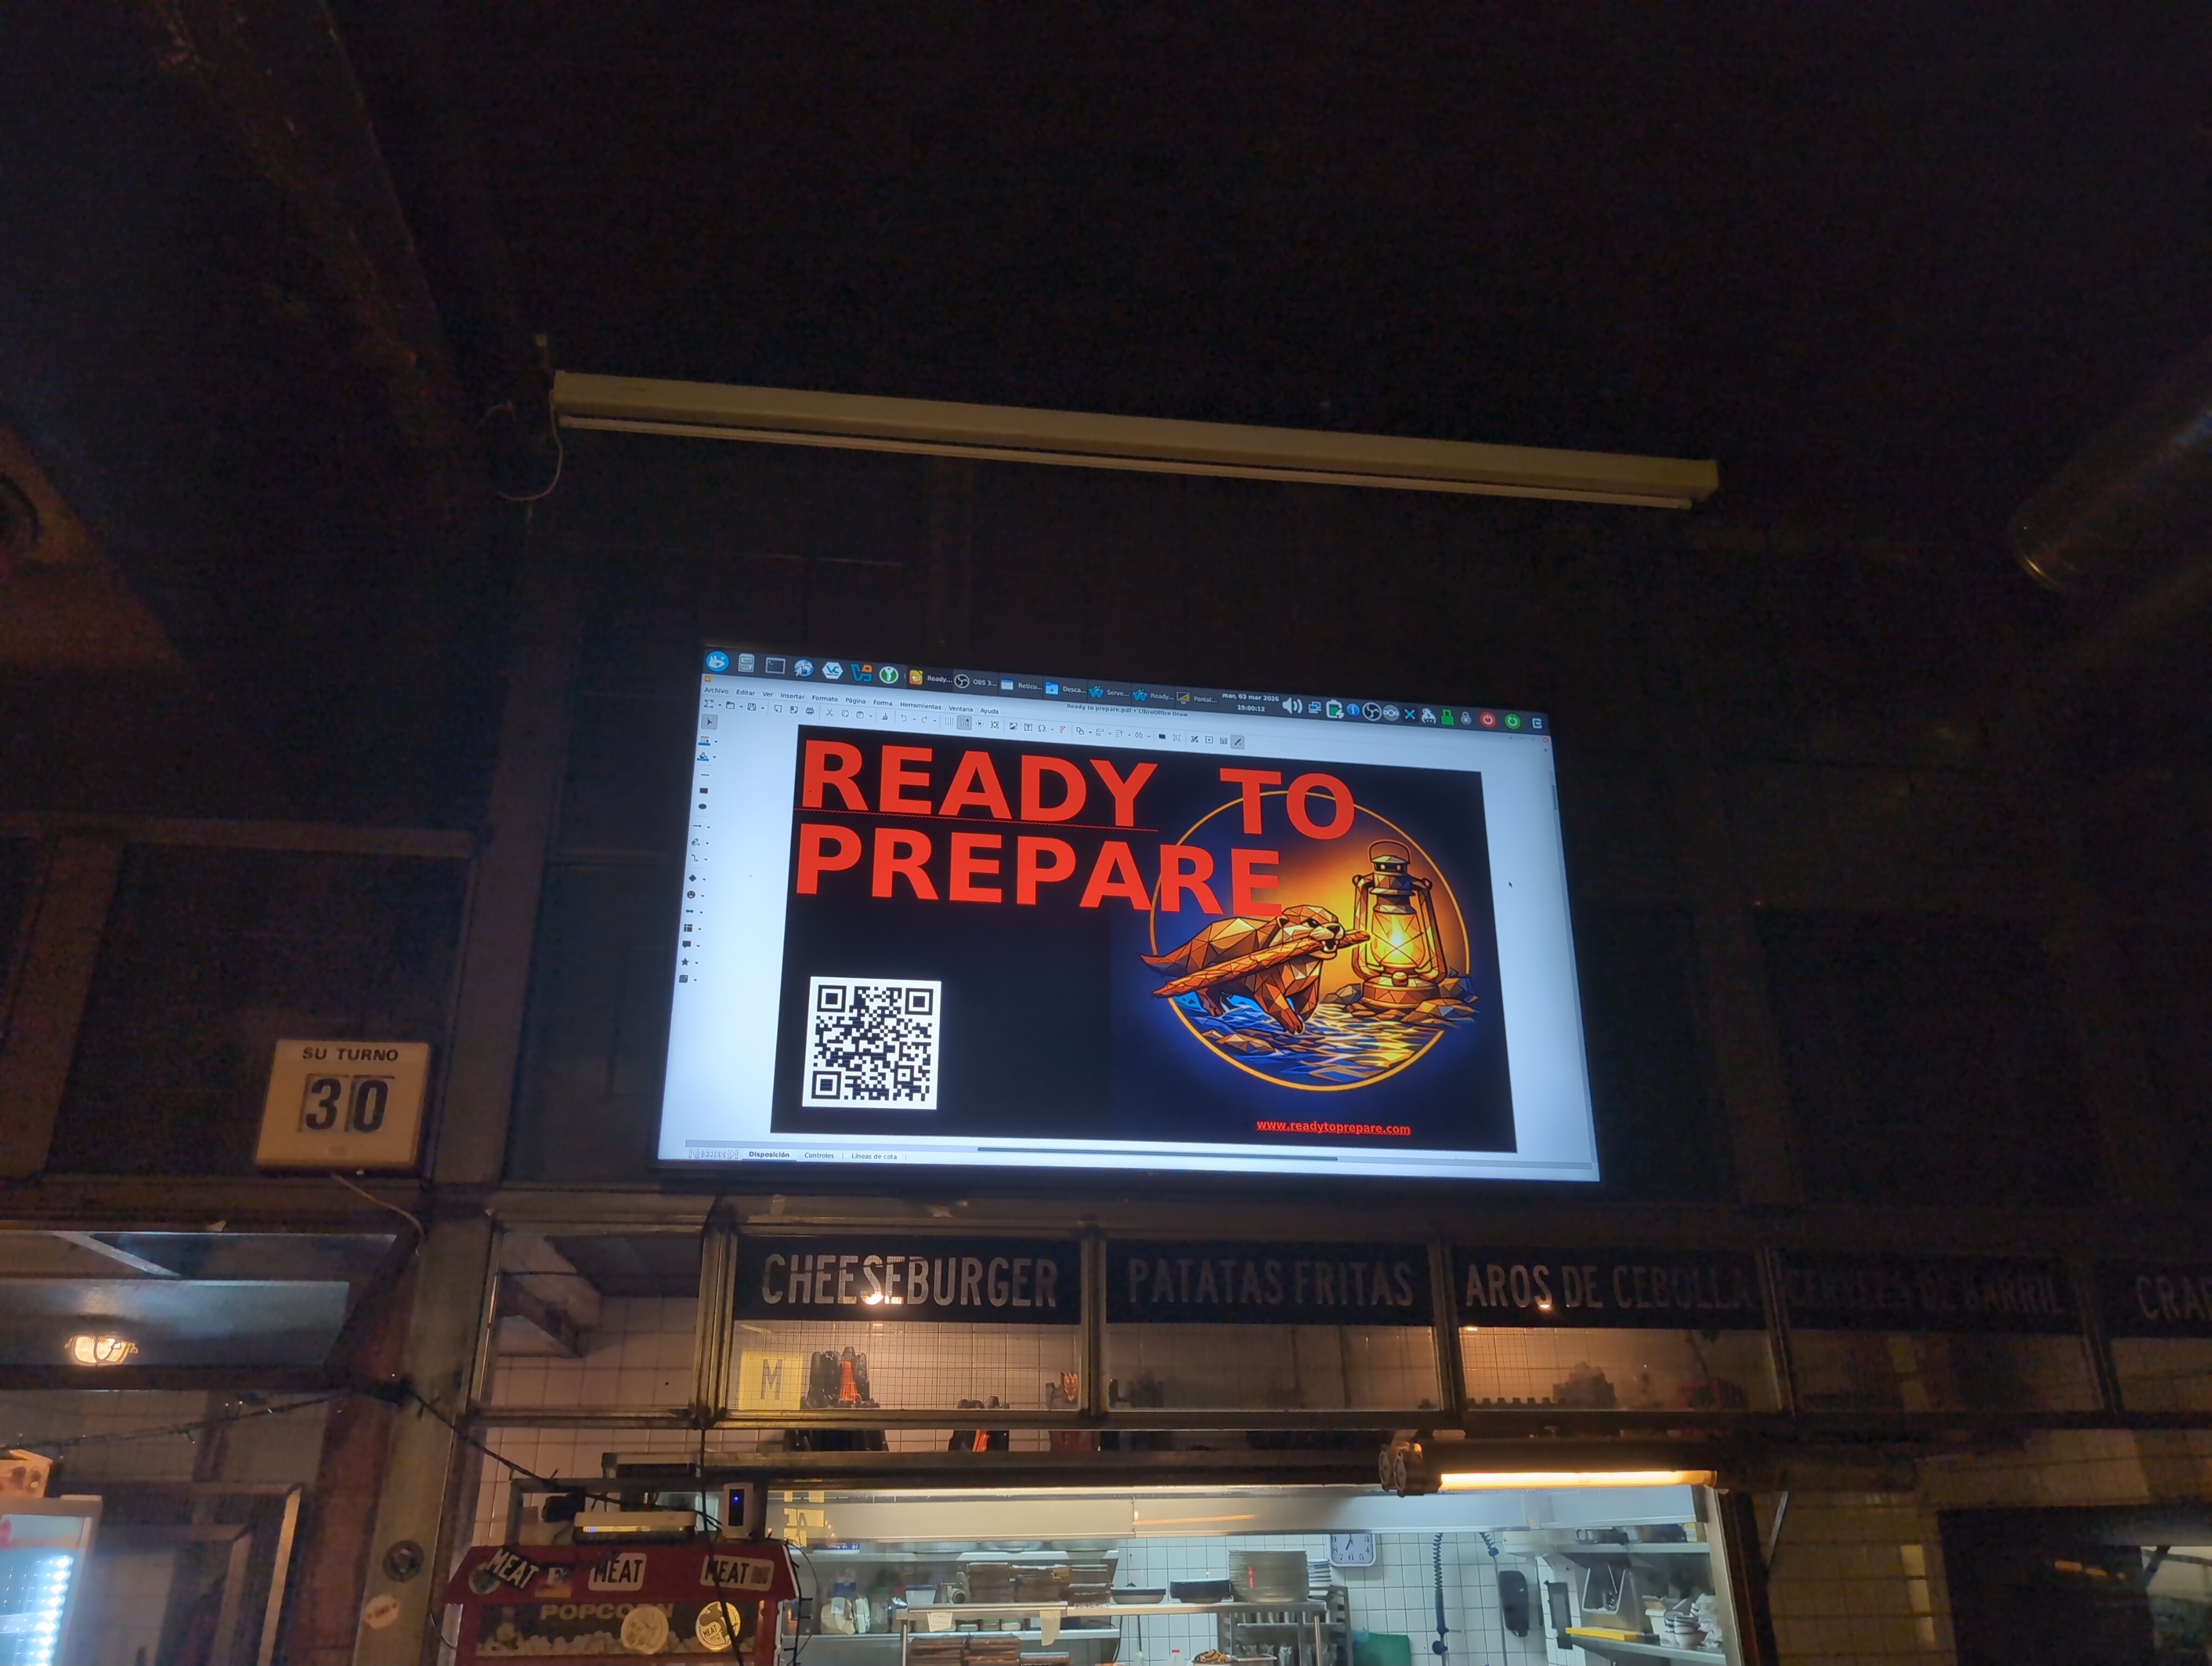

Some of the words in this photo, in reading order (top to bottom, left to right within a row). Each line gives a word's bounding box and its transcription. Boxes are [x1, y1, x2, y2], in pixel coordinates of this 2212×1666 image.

[927, 675, 953, 683] Ready...
[1063, 685, 1087, 694] Desca...
[1150, 693, 1175, 701] Ready...
[900, 701, 942, 710] Herramientas
[1096, 706, 1131, 714] prepare.pdf
[802, 739, 1158, 827] READY
[1219, 767, 1355, 840] TO
[796, 823, 1283, 917] PREPARE
[303, 1047, 327, 1060] SU
[336, 1048, 399, 1061] TURNO
[306, 1078, 389, 1133] 30
[1256, 1120, 1411, 1135] www.readytoprepare.com
[749, 1150, 790, 1159] Disposición
[761, 1254, 1057, 1307] CHEESEBURGER
[1128, 1258, 1283, 1304] PATATAS
[1295, 1260, 1413, 1306] FRITAS
[1465, 1264, 1553, 1309] AROS
[1561, 1265, 1603, 1308] DE
[487, 1548, 539, 1589] MEAT
[541, 1603, 673, 1620] POPCON
